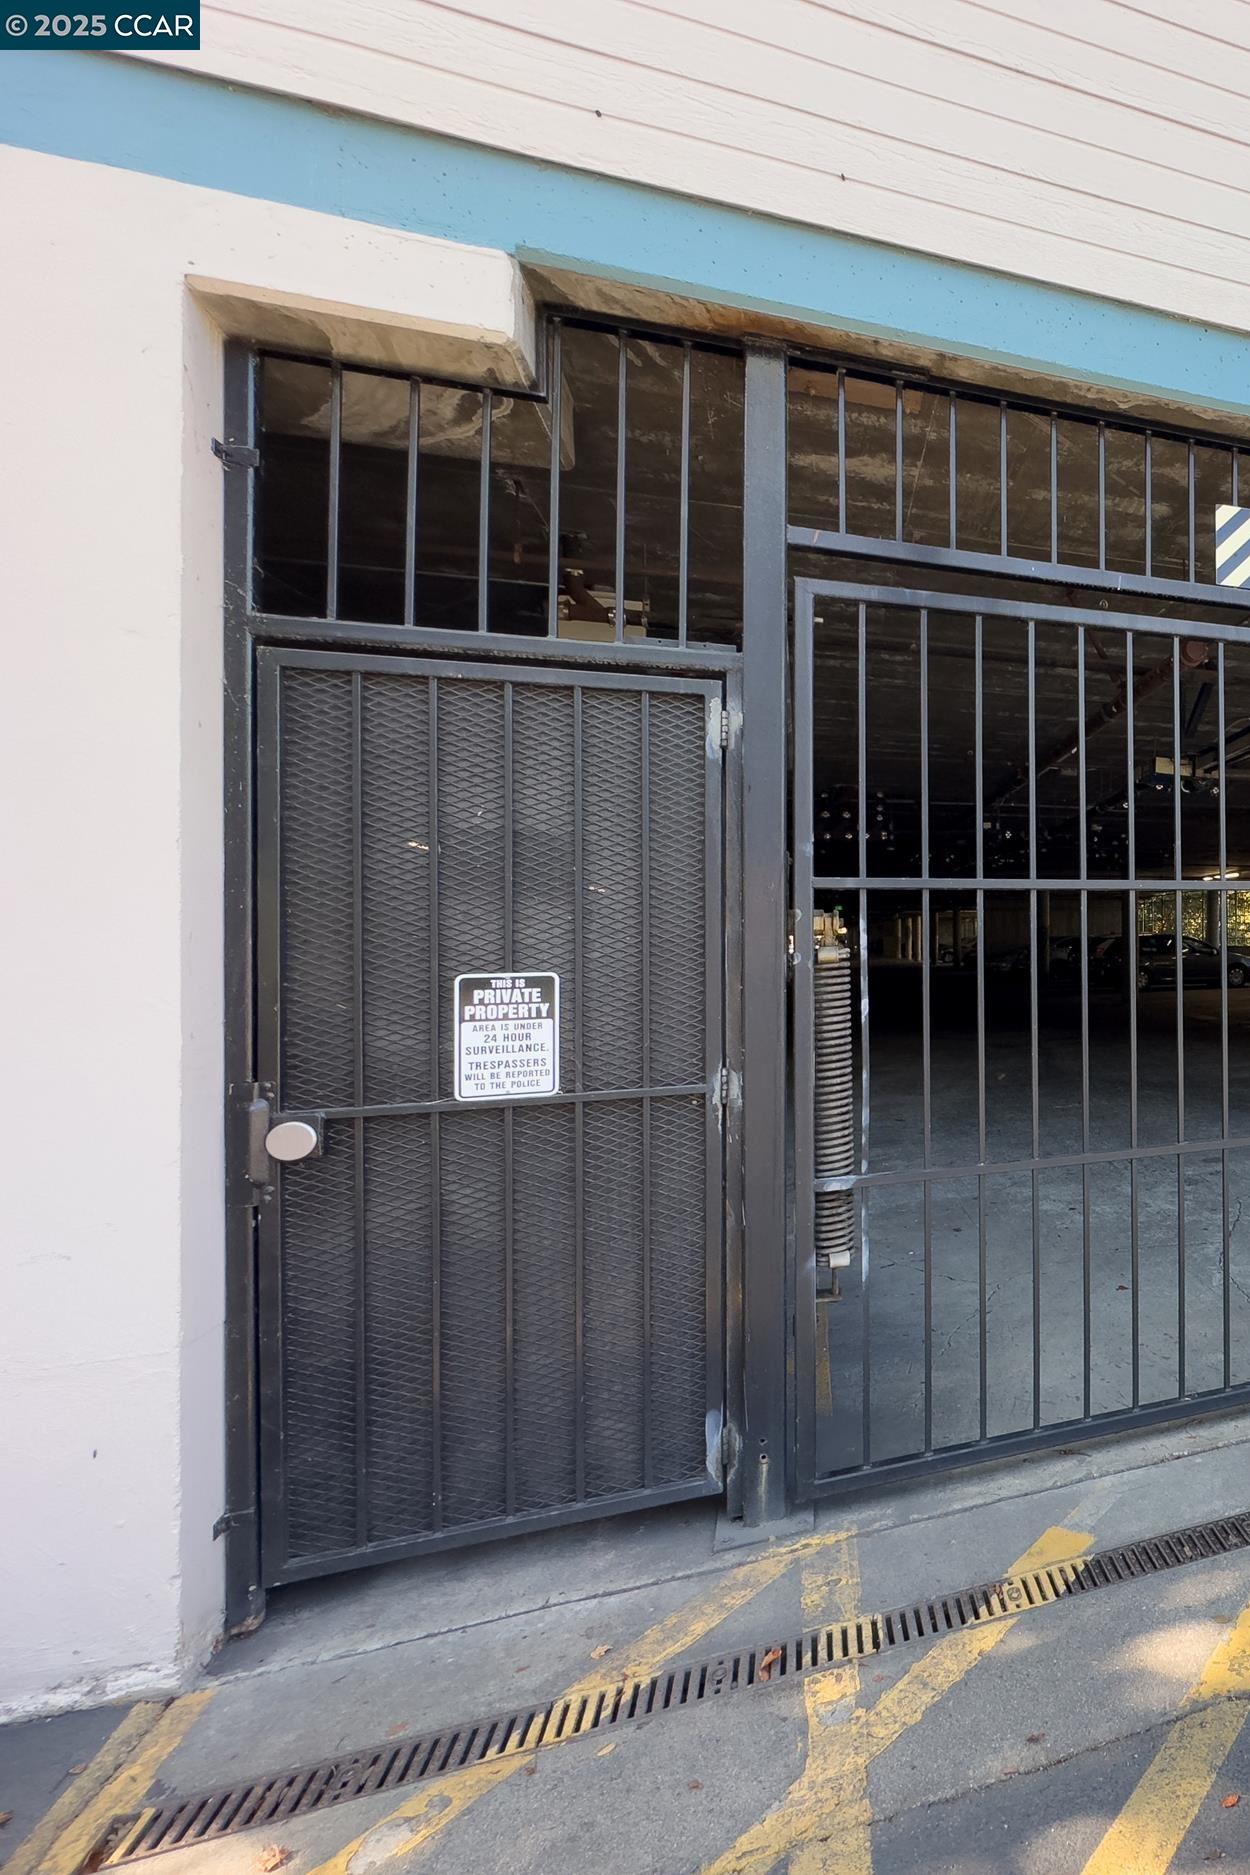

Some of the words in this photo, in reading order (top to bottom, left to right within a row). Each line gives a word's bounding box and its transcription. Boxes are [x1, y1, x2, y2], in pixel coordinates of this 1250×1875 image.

[490, 980, 512, 988] THIS
[515, 979, 525, 987] IS
[473, 988, 541, 1004] PRIVATE
[464, 1003, 550, 1020] PROPERTY
[472, 1024, 496, 1032] AREA
[501, 1023, 509, 1031] IS
[514, 1022, 543, 1030] UNDER
[484, 1034, 497, 1043] 24
[503, 1033, 531, 1042] HOUR
[465, 1043, 549, 1056] SURVEILLANCE.
[468, 1058, 547, 1071] TRESPASSERS
[490, 1072, 500, 1080] BE
[506, 1069, 550, 1079] REPORTED
[475, 1082, 485, 1091] TO
[490, 1081, 506, 1089] THE
[511, 1079, 541, 1088] POLICE
